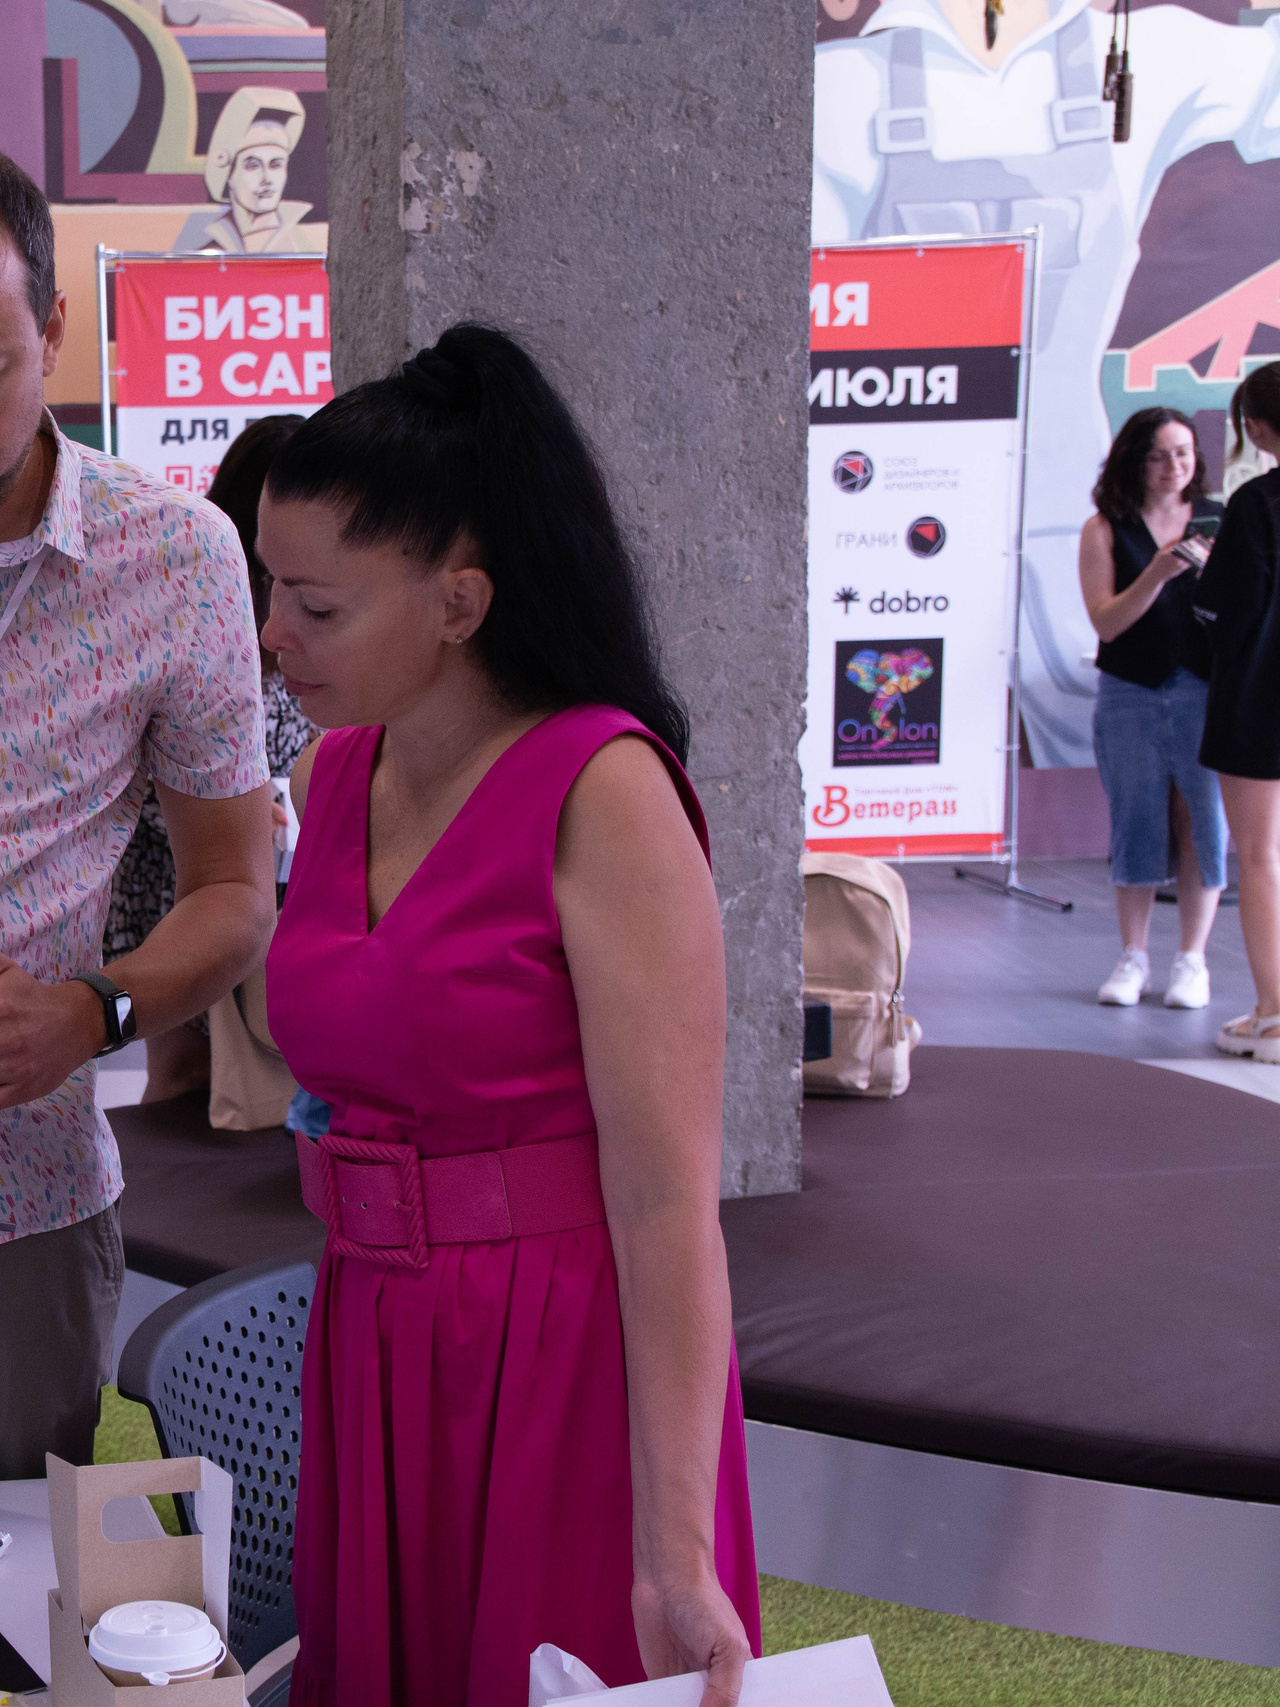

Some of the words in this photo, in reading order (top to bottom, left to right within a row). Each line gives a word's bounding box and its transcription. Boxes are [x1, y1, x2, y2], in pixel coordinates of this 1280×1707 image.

[164, 294, 327, 341] БИЗН
[166, 353, 204, 398] В
[835, 531, 898, 549] ГРАНИ
[869, 588, 950, 615] dobro
[812, 785, 957, 827] Ветеран
